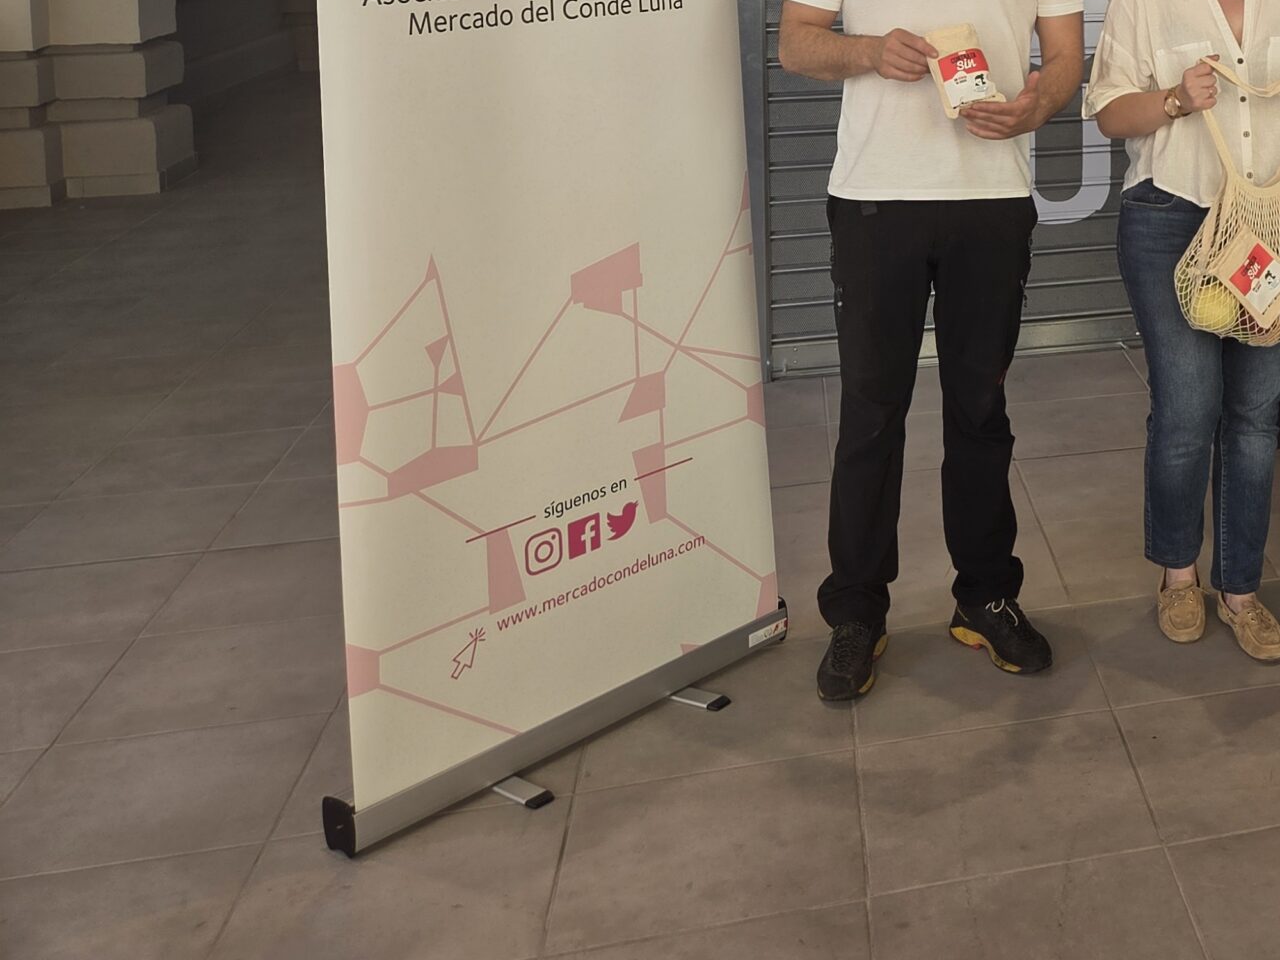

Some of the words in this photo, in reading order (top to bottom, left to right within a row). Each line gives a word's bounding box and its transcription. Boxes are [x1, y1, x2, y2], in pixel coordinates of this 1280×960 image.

[408, 4, 514, 36] Mercado
[544, 486, 607, 520] síguenos
[610, 478, 627, 494] en
[497, 535, 706, 631] www.mercadocondeluna.com
